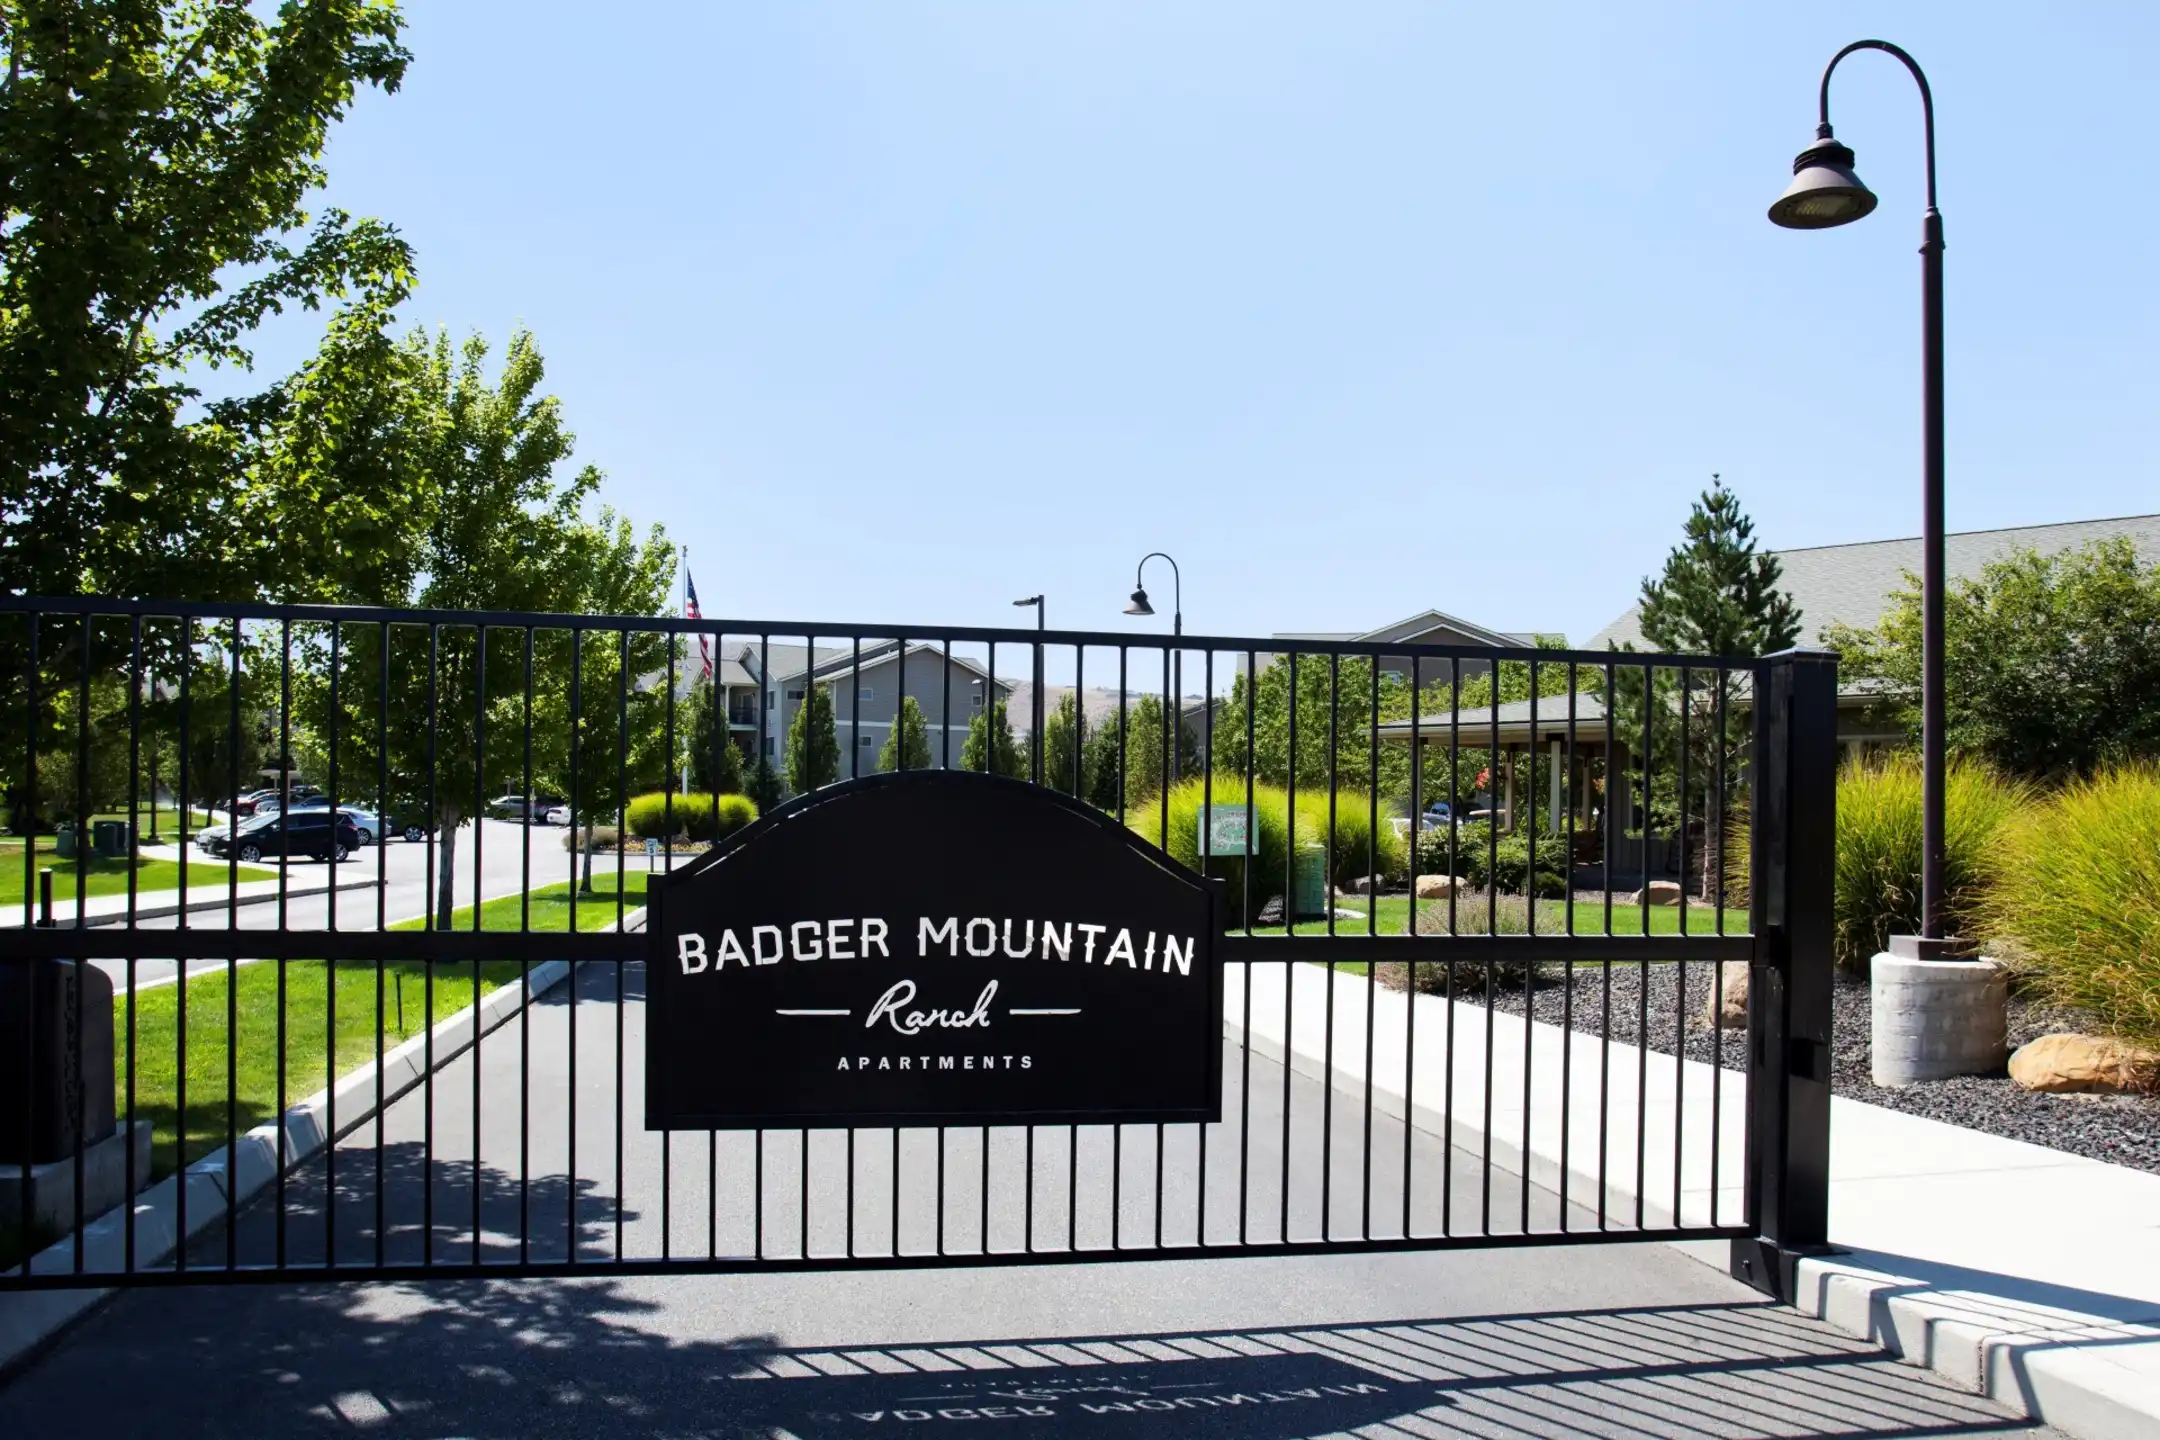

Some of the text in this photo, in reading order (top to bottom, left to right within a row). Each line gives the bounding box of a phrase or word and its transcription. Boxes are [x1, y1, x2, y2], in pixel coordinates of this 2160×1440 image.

[677, 916, 1195, 977] BADGER MOUNTAIN
[865, 979, 999, 1036] Ranch
[837, 1055, 1032, 1071] APARTMENTS
